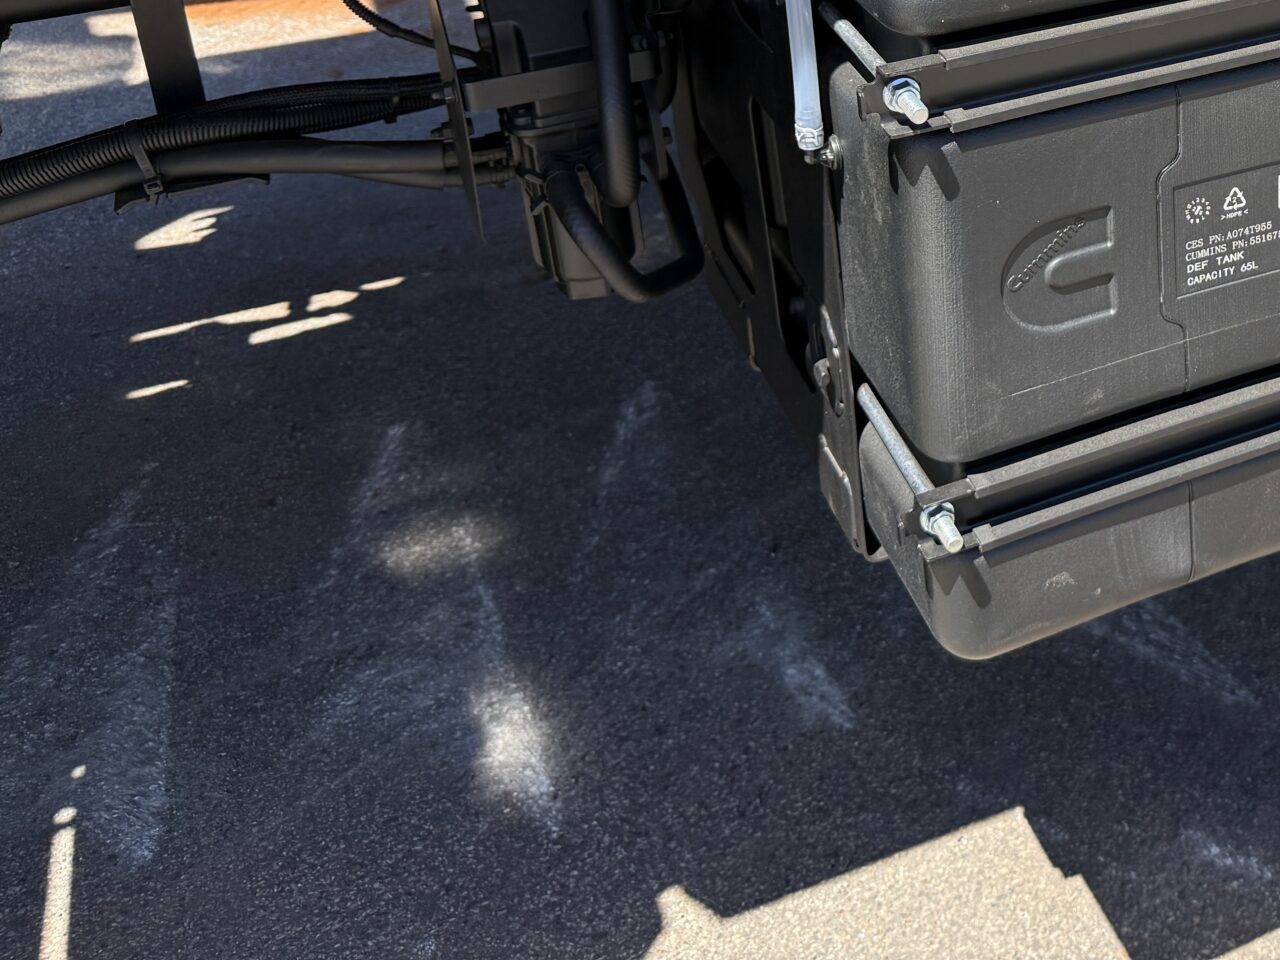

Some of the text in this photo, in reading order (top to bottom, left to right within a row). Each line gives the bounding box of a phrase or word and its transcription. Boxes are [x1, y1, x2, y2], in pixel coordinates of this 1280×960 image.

[1007, 216, 1088, 293] Cummins
[1185, 238, 1204, 250] CES
[1185, 244, 1227, 261] CUMMINS
[1187, 251, 1244, 273] DEF TANK
[1187, 261, 1258, 286] CAPACITY 65L
